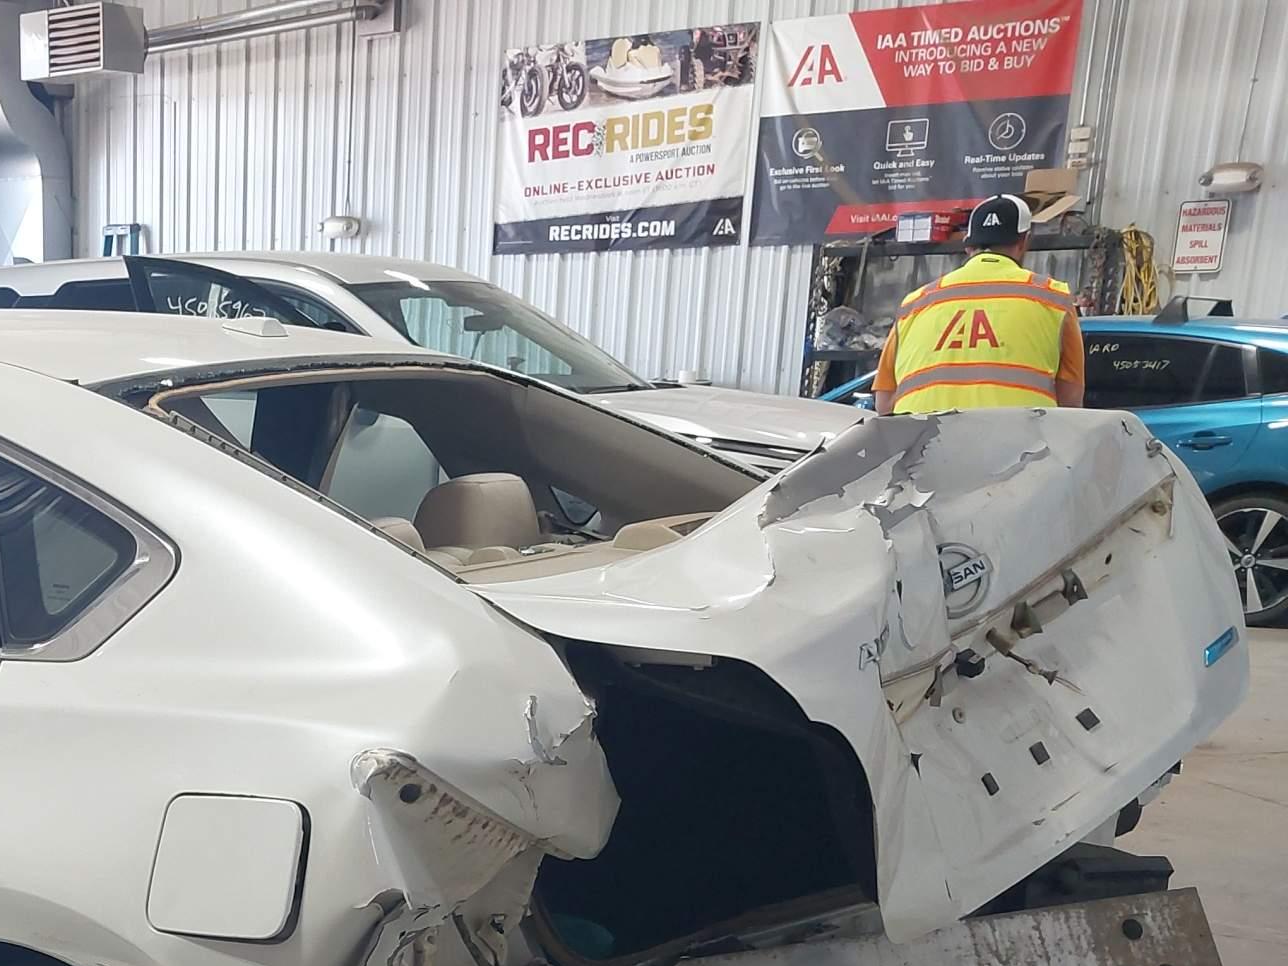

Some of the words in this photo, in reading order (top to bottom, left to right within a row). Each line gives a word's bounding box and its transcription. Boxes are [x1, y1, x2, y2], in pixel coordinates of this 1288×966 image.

[878, 32, 907, 50] IAA
[911, 28, 962, 47] TIMED
[895, 42, 992, 63] INTRODUCING
[996, 41, 1007, 54] A
[1012, 37, 1048, 52] NEW
[903, 61, 934, 78] WAY
[938, 60, 955, 75] TO
[961, 58, 984, 73] BID
[987, 56, 999, 70] &
[1004, 53, 1036, 69] BUY
[527, 121, 596, 163] REC
[606, 103, 715, 153] RIDES
[635, 149, 680, 163] POWERSPORT
[681, 143, 712, 158] AUCTION
[964, 154, 1007, 164] Real-Time
[1008, 153, 1045, 164] Updates
[769, 166, 804, 176] Exclusive
[805, 165, 823, 174] First
[873, 161, 897, 170] Quick
[898, 160, 914, 169] and
[915, 159, 935, 169] Easy
[524, 172, 651, 198] ONLINE-EXCLUSIVE
[655, 163, 715, 182] AUCTION
[850, 214, 870, 224] Visit
[1182, 206, 1226, 217] HAZARDOUS
[549, 220, 675, 242] RECRIDES.COM
[1182, 222, 1222, 233] MATERIALS
[1189, 239, 1208, 249] SPILL
[1176, 255, 1218, 265] ABSORBENT
[951, 559, 987, 586] SAN
